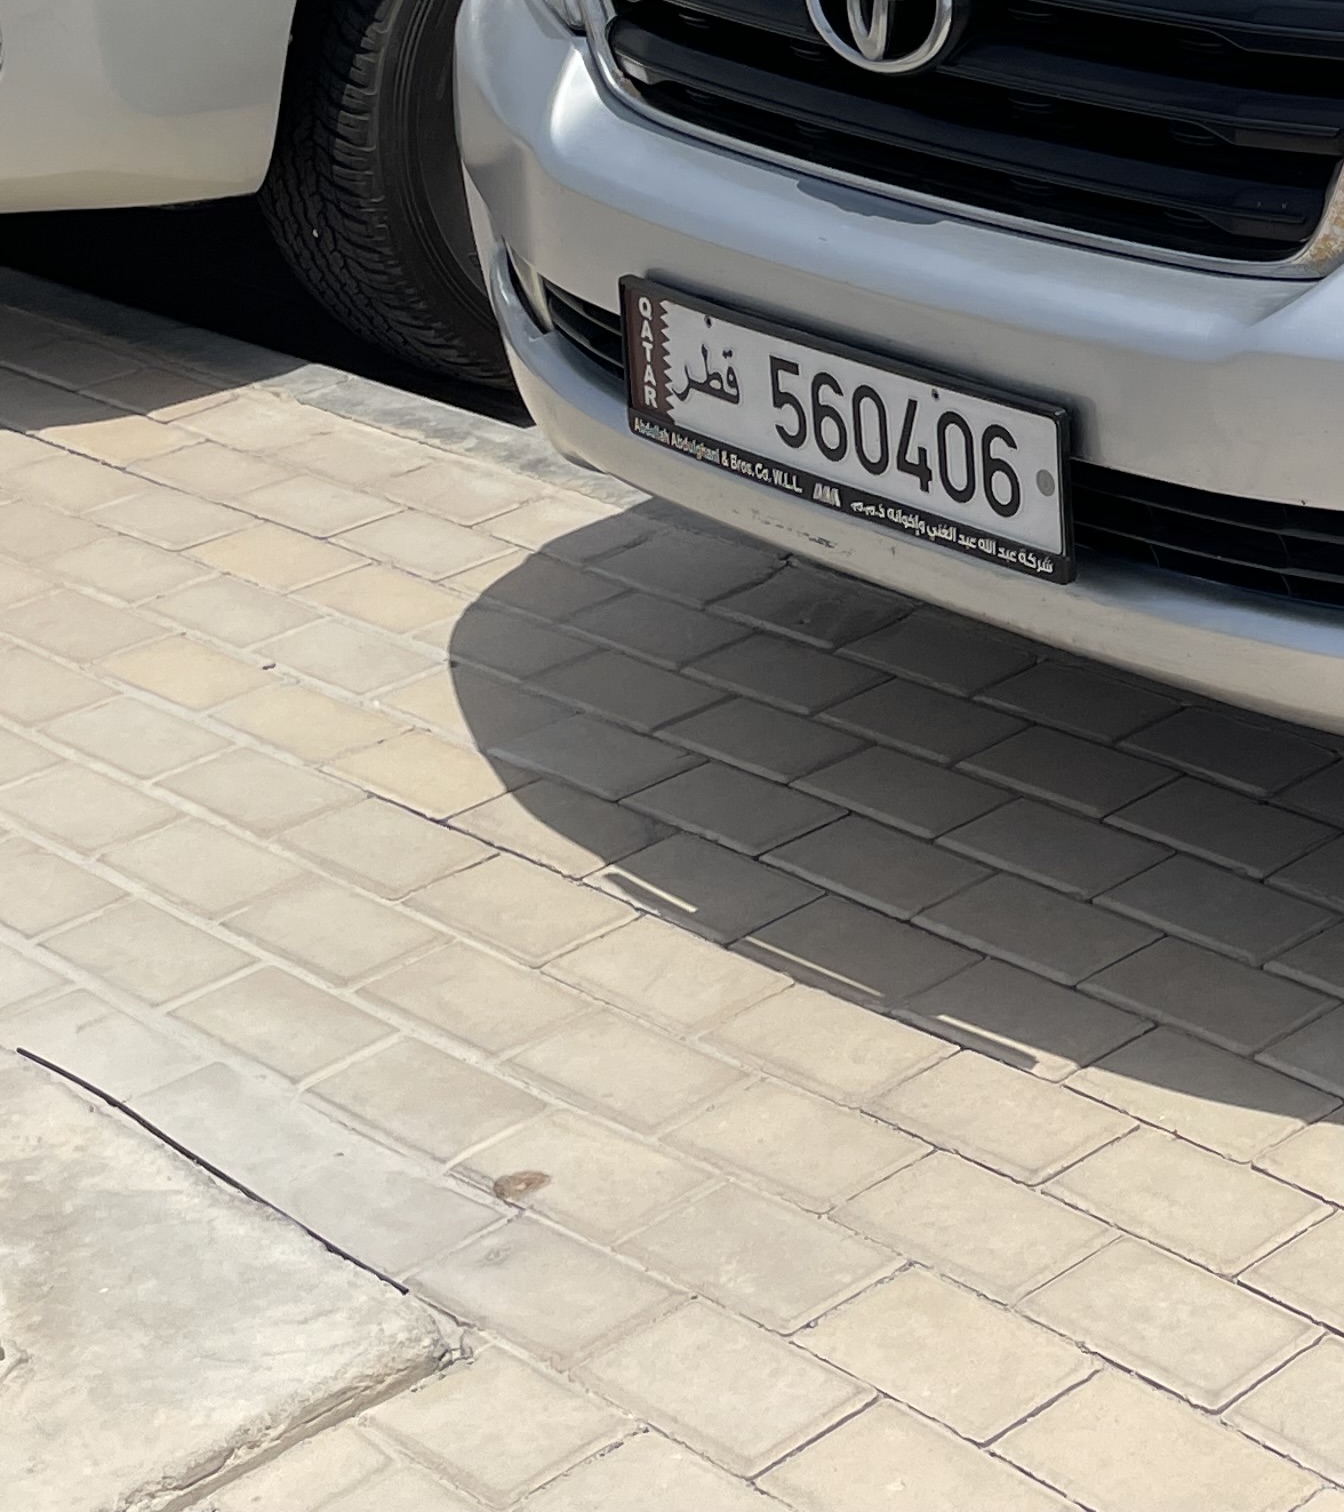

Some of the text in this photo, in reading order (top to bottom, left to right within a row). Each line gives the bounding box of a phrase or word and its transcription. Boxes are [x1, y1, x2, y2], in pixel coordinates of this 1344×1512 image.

[637, 296, 659, 409] QATAR
[672, 344, 741, 405] قطر
[769, 355, 1021, 519] 560406
